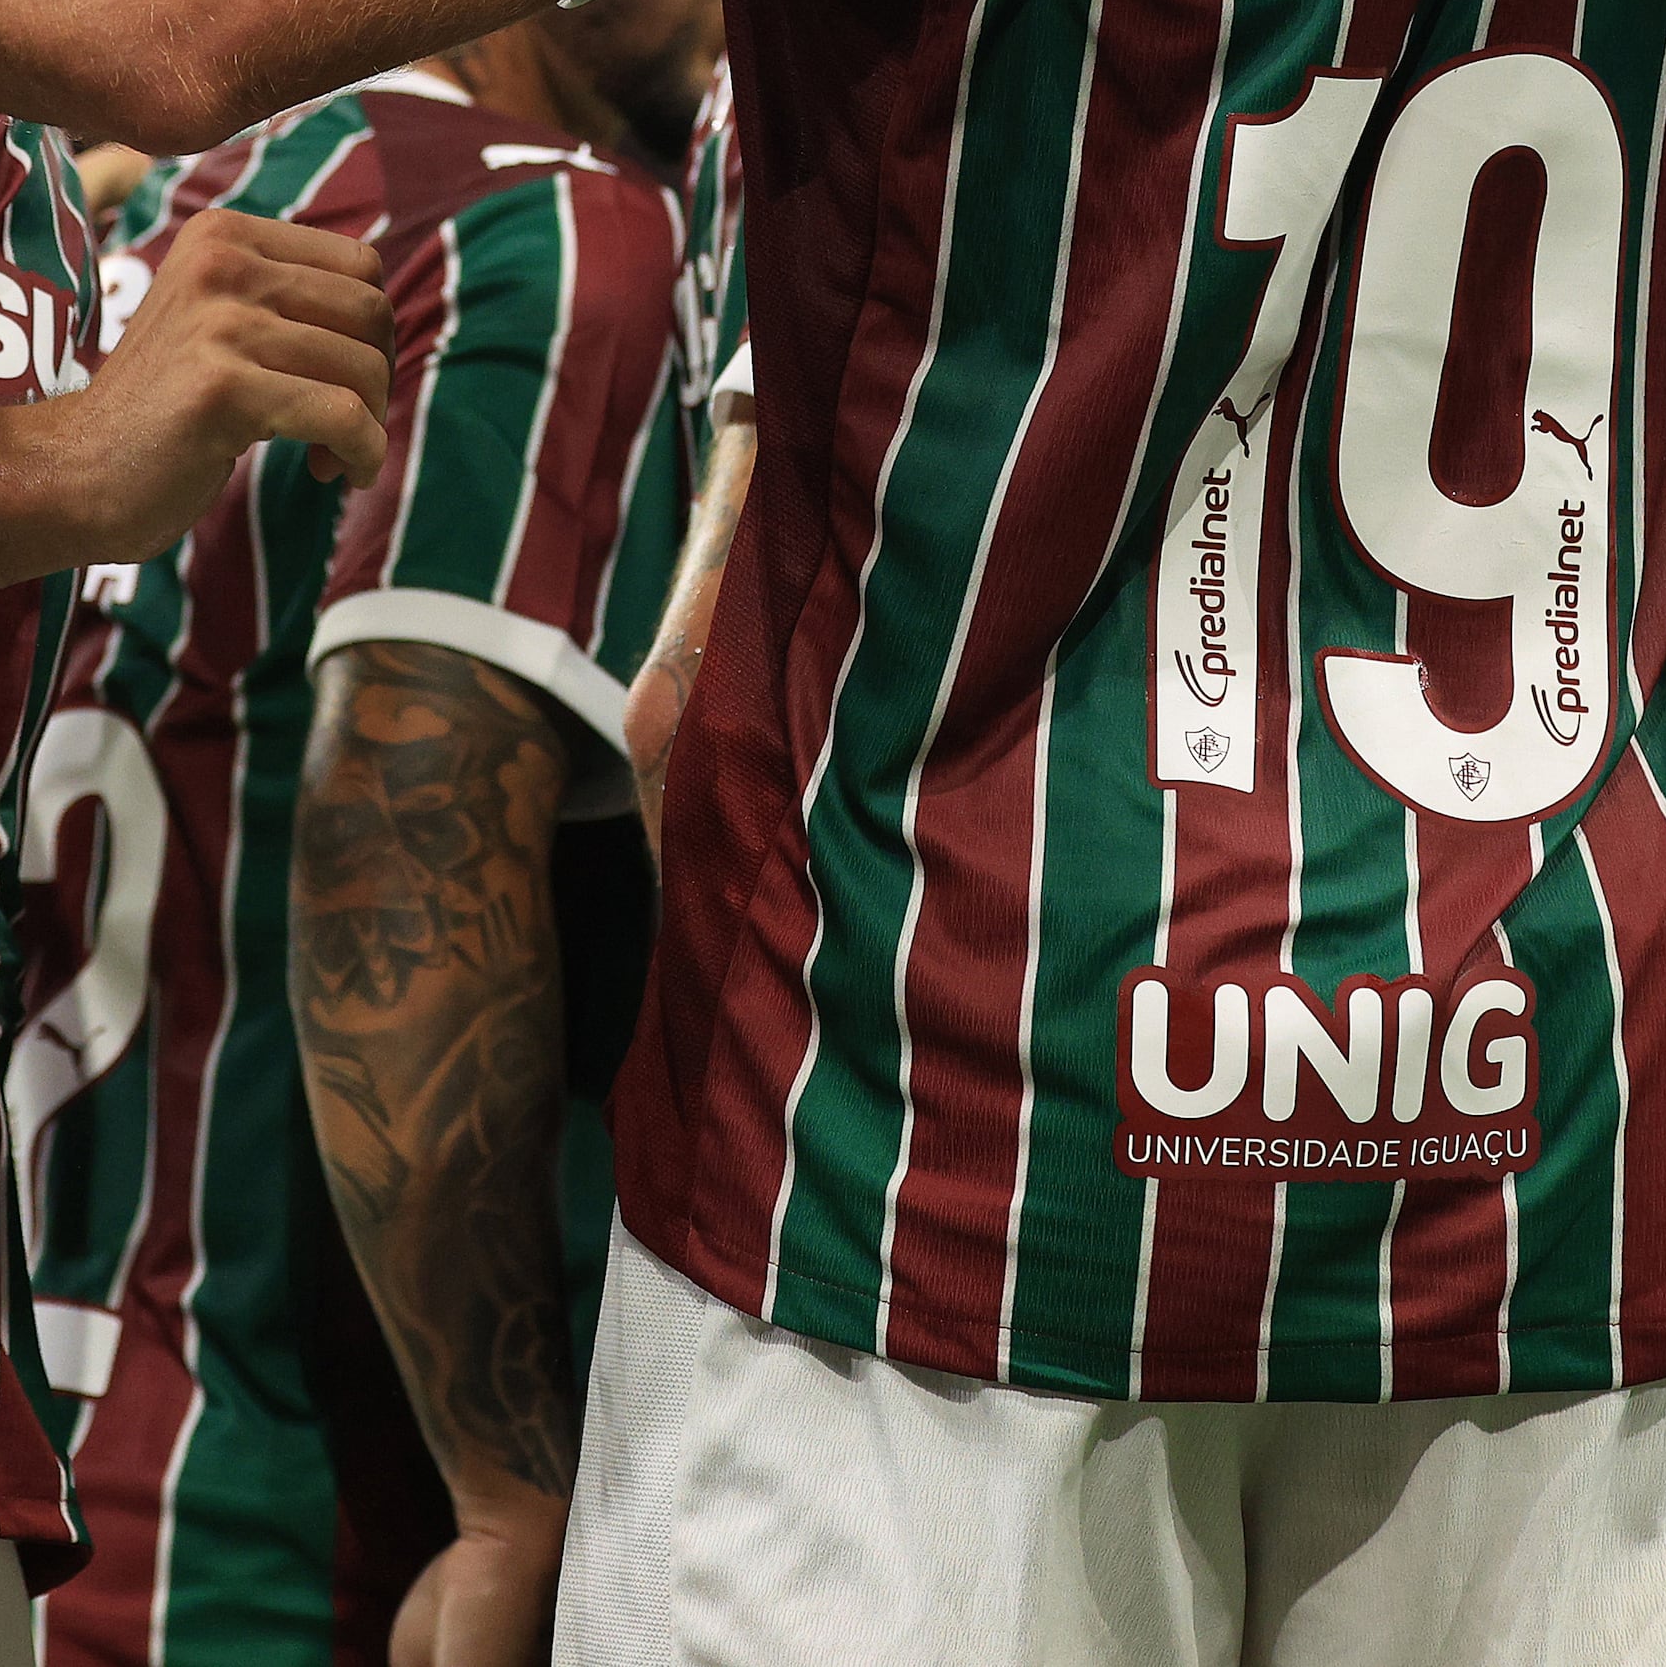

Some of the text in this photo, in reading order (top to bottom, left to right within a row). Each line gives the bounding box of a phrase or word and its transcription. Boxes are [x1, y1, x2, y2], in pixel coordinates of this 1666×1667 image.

[1157, 53, 1623, 822] 19
[1190, 467, 1237, 676] predialnet
[1545, 499, 1589, 713] predialnet
[1127, 1128, 1528, 1169] UNIVERSIDADE IGUAÇU
[1131, 979, 1528, 1124] UNIG
